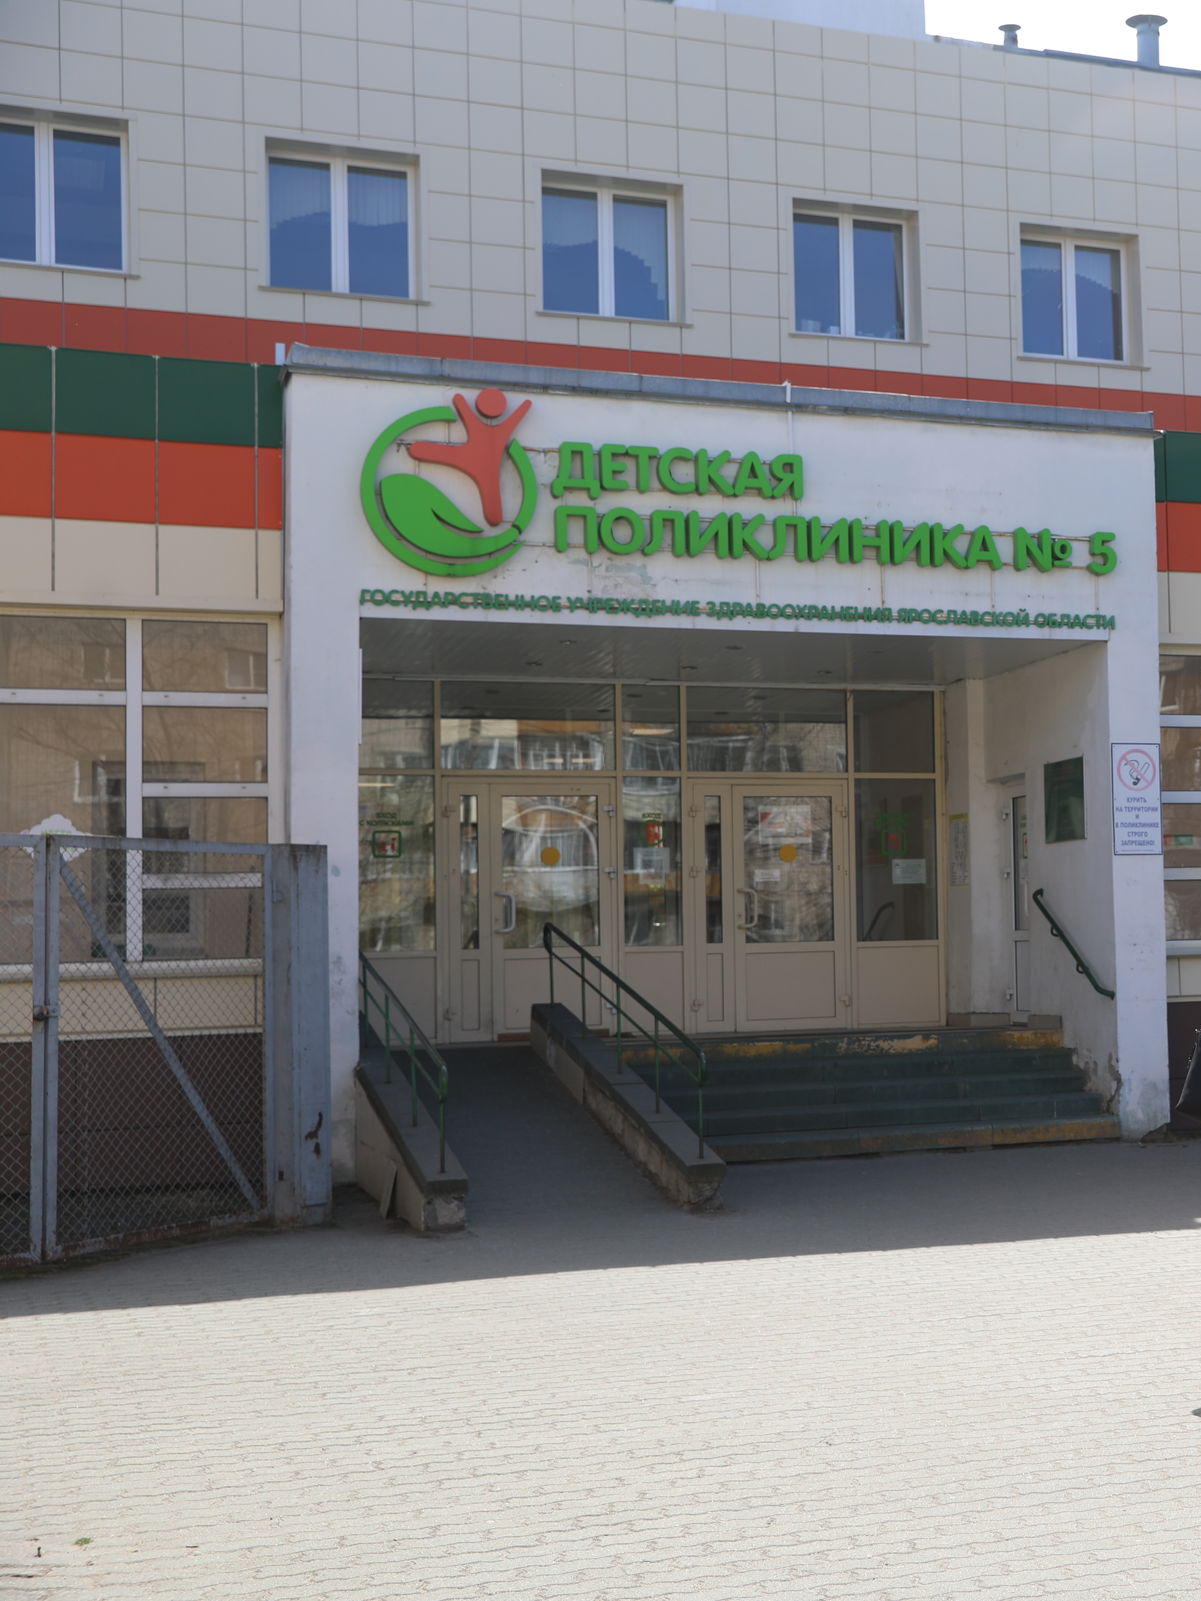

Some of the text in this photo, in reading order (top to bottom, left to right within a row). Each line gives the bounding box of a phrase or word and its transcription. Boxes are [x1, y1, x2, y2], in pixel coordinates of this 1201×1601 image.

[551, 441, 804, 500] ДЕТСКАЯ
[554, 505, 1118, 575] ПОЛИКЛИНИКА № 5
[359, 589, 1116, 630] ГОСУДАРСТВЕННОЕ УЧРЕЖДЕНИЕ ЗДРАВООХРАНЕНИЯ ЯРОСЛАВСКОЙ ОБЛАСТИ
